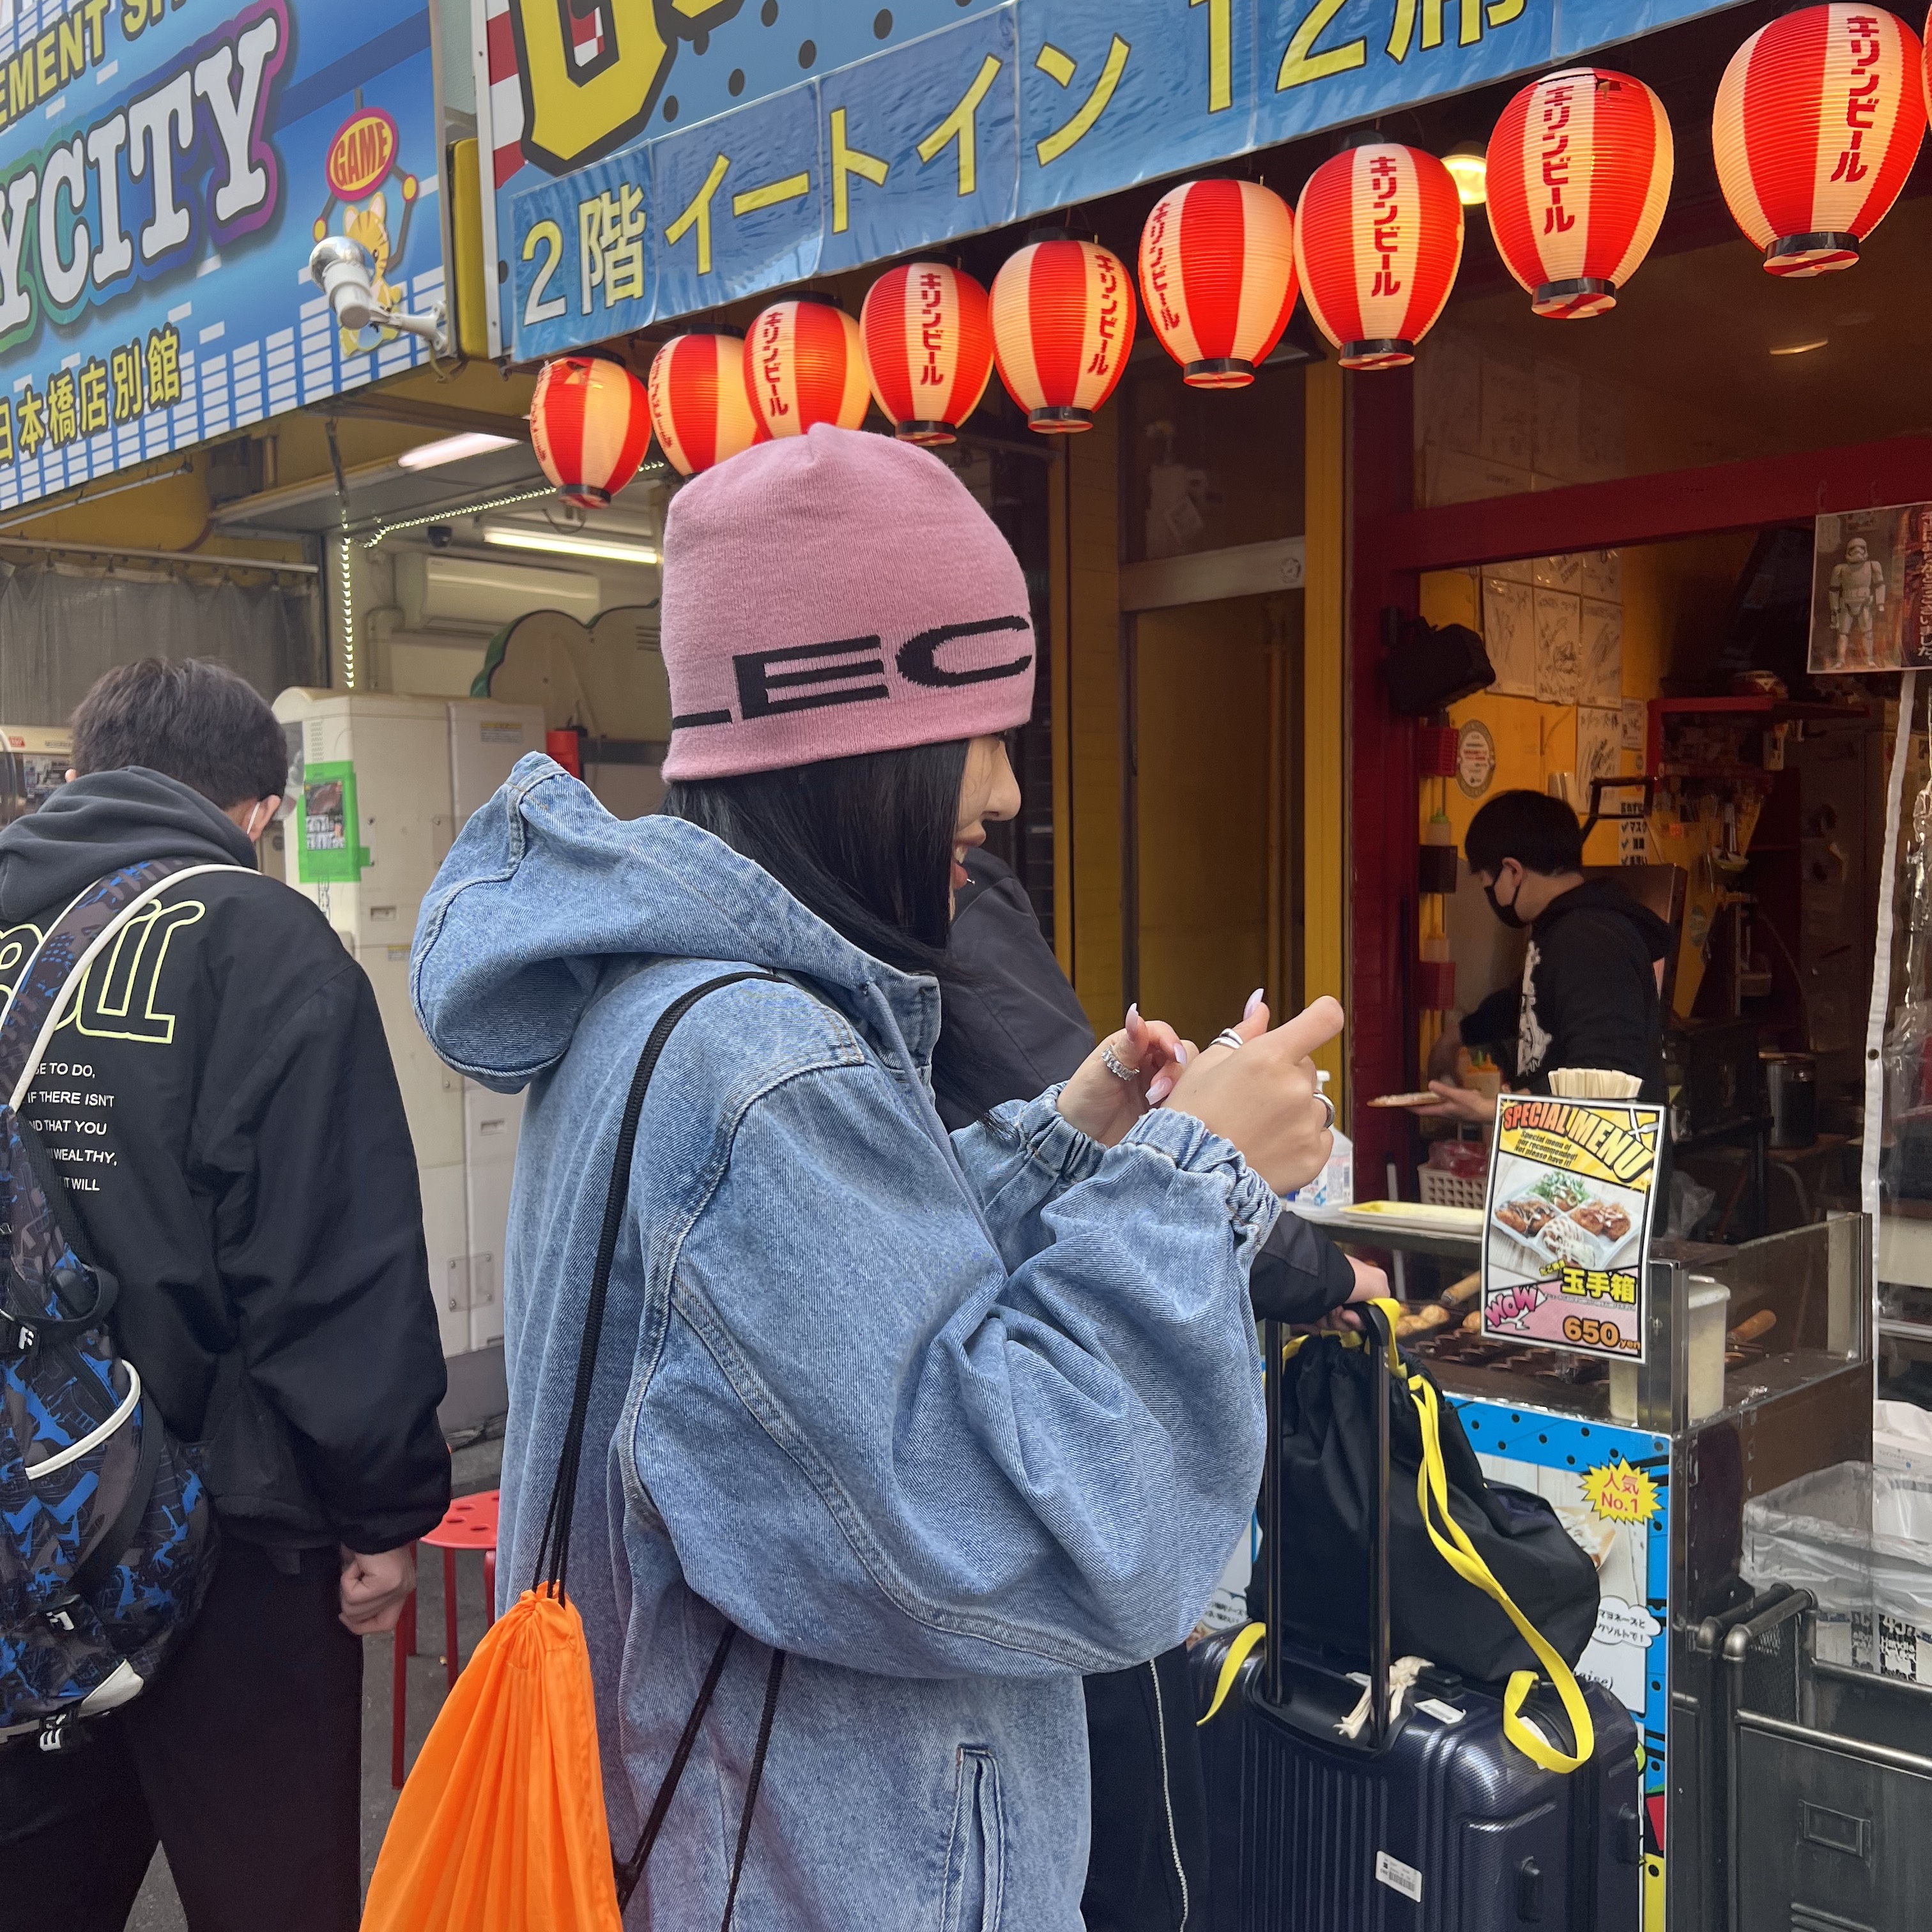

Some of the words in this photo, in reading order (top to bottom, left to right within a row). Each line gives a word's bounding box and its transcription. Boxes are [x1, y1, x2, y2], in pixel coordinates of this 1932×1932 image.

[1830, 15, 1880, 182] キリンビール
[334, 121, 387, 187] GAME
[1542, 85, 1575, 236] キリンビール
[1370, 157, 1401, 297] キリンビール
[920, 273, 944, 386] キリンビール
[1087, 255, 1118, 376] キリンビール
[764, 311, 789, 417] キリンビール
[0, 329, 180, 463] 日本橋店別館
[49, 1063, 68, 1075] TO
[72, 1064, 95, 1078] DO,
[27, 1091, 36, 1103] IF
[39, 1091, 81, 1105] THERE
[85, 1093, 114, 1107] ISN'T
[44, 1120, 71, 1131] THAT
[75, 1121, 107, 1135] YOU
[1503, 1102, 1572, 1137] SPECIAL
[1568, 1107, 1653, 1181] MENU
[1521, 1130, 1545, 1143] Special
[1545, 1138, 1564, 1149] menu
[53, 1148, 117, 1166] WEALTHY,
[1525, 1148, 1547, 1160] please
[1547, 1154, 1563, 1165] have
[72, 1178, 100, 1191] WILL
[1561, 1267, 1636, 1304] 玉手箱
[1484, 1285, 1538, 1328] WOW
[1563, 1315, 1620, 1348] 650
[1620, 1339, 1641, 1350] yen
[1603, 1471, 1639, 1496] 人気
